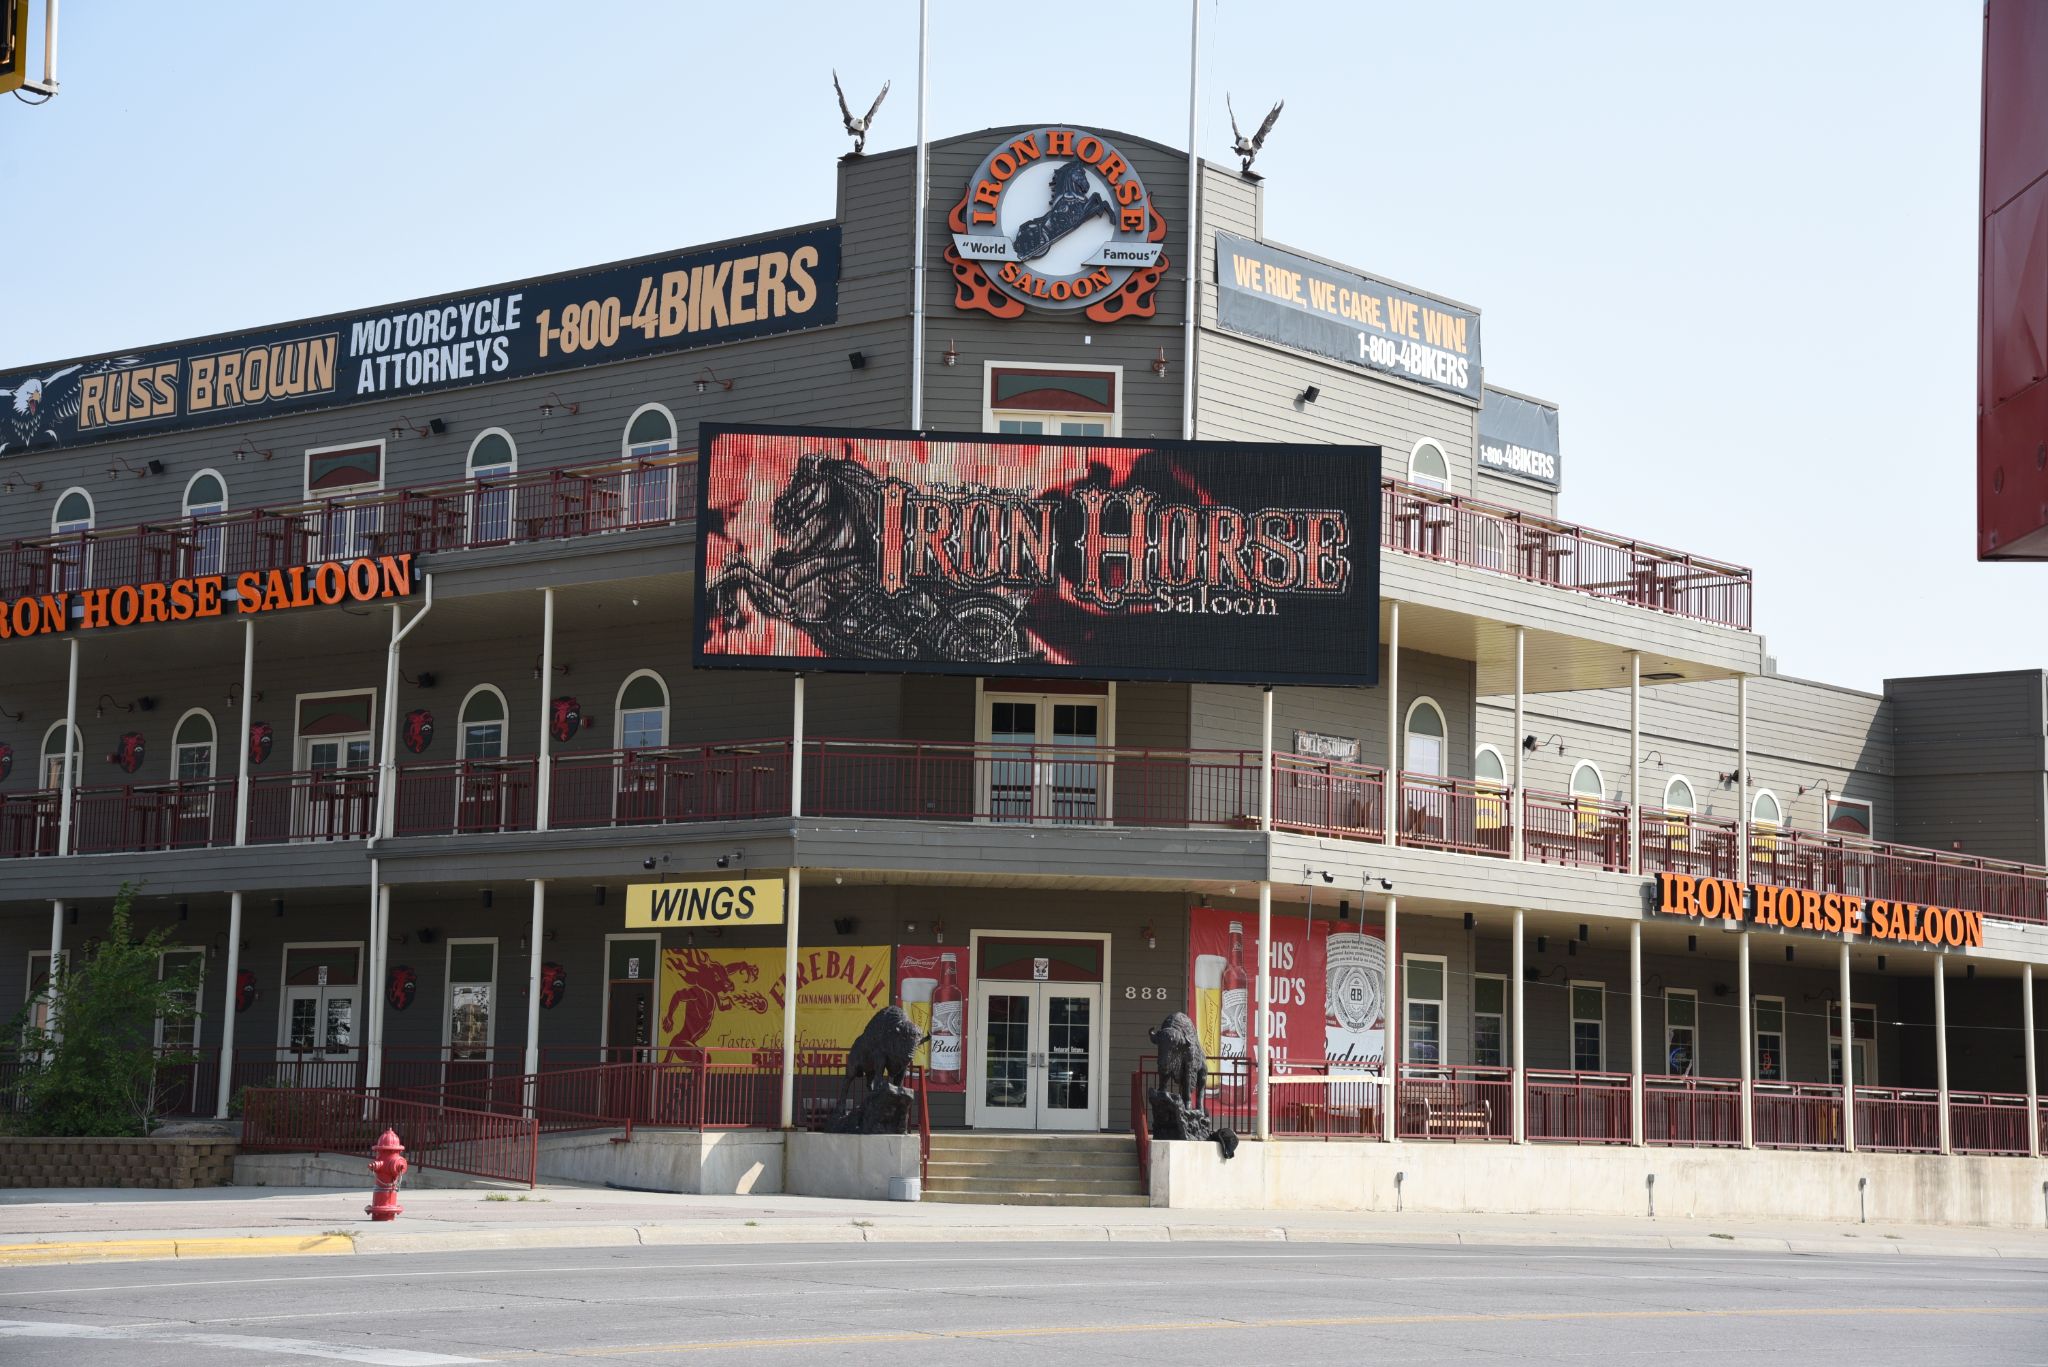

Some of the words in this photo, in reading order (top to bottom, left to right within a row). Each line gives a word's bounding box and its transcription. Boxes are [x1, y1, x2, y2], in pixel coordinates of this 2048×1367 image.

[973, 133, 1041, 226] IRON
[1046, 130, 1145, 232] HORSE
[535, 245, 819, 358] 1-800-4BIKERS
[998, 261, 1113, 301] SALOON
[1233, 254, 1262, 292] WE
[1264, 263, 1307, 309] RIDE,
[1309, 277, 1337, 314] WE
[1339, 287, 1386, 333] CARE,
[1387, 296, 1420, 340] WE
[1423, 307, 1467, 354] WIN!
[349, 293, 523, 357] MOTORCYCLE
[78, 359, 181, 432] RUSS
[187, 332, 340, 415] BROWN
[357, 335, 509, 395] ATTORNEYS
[1358, 332, 1468, 389] 1-800-4BIKERS
[1479, 444, 1555, 479] 1-800-4BIKERS
[873, 479, 1060, 598] IRON
[1073, 485, 1351, 606] HORSE
[80, 576, 223, 629] HORSE
[236, 553, 413, 613] SALOON
[1156, 585, 1280, 616] Saloon
[651, 886, 756, 921] WINGS
[1661, 873, 1744, 921] IRON
[1755, 885, 1862, 934] HORSE
[1871, 900, 1983, 948] SALOON
[798, 994, 832, 1005] CINNAMON
[834, 994, 860, 1005] WHISKY
[1125, 986, 1167, 1001] 888
[718, 1029, 756, 1049] Tastes
